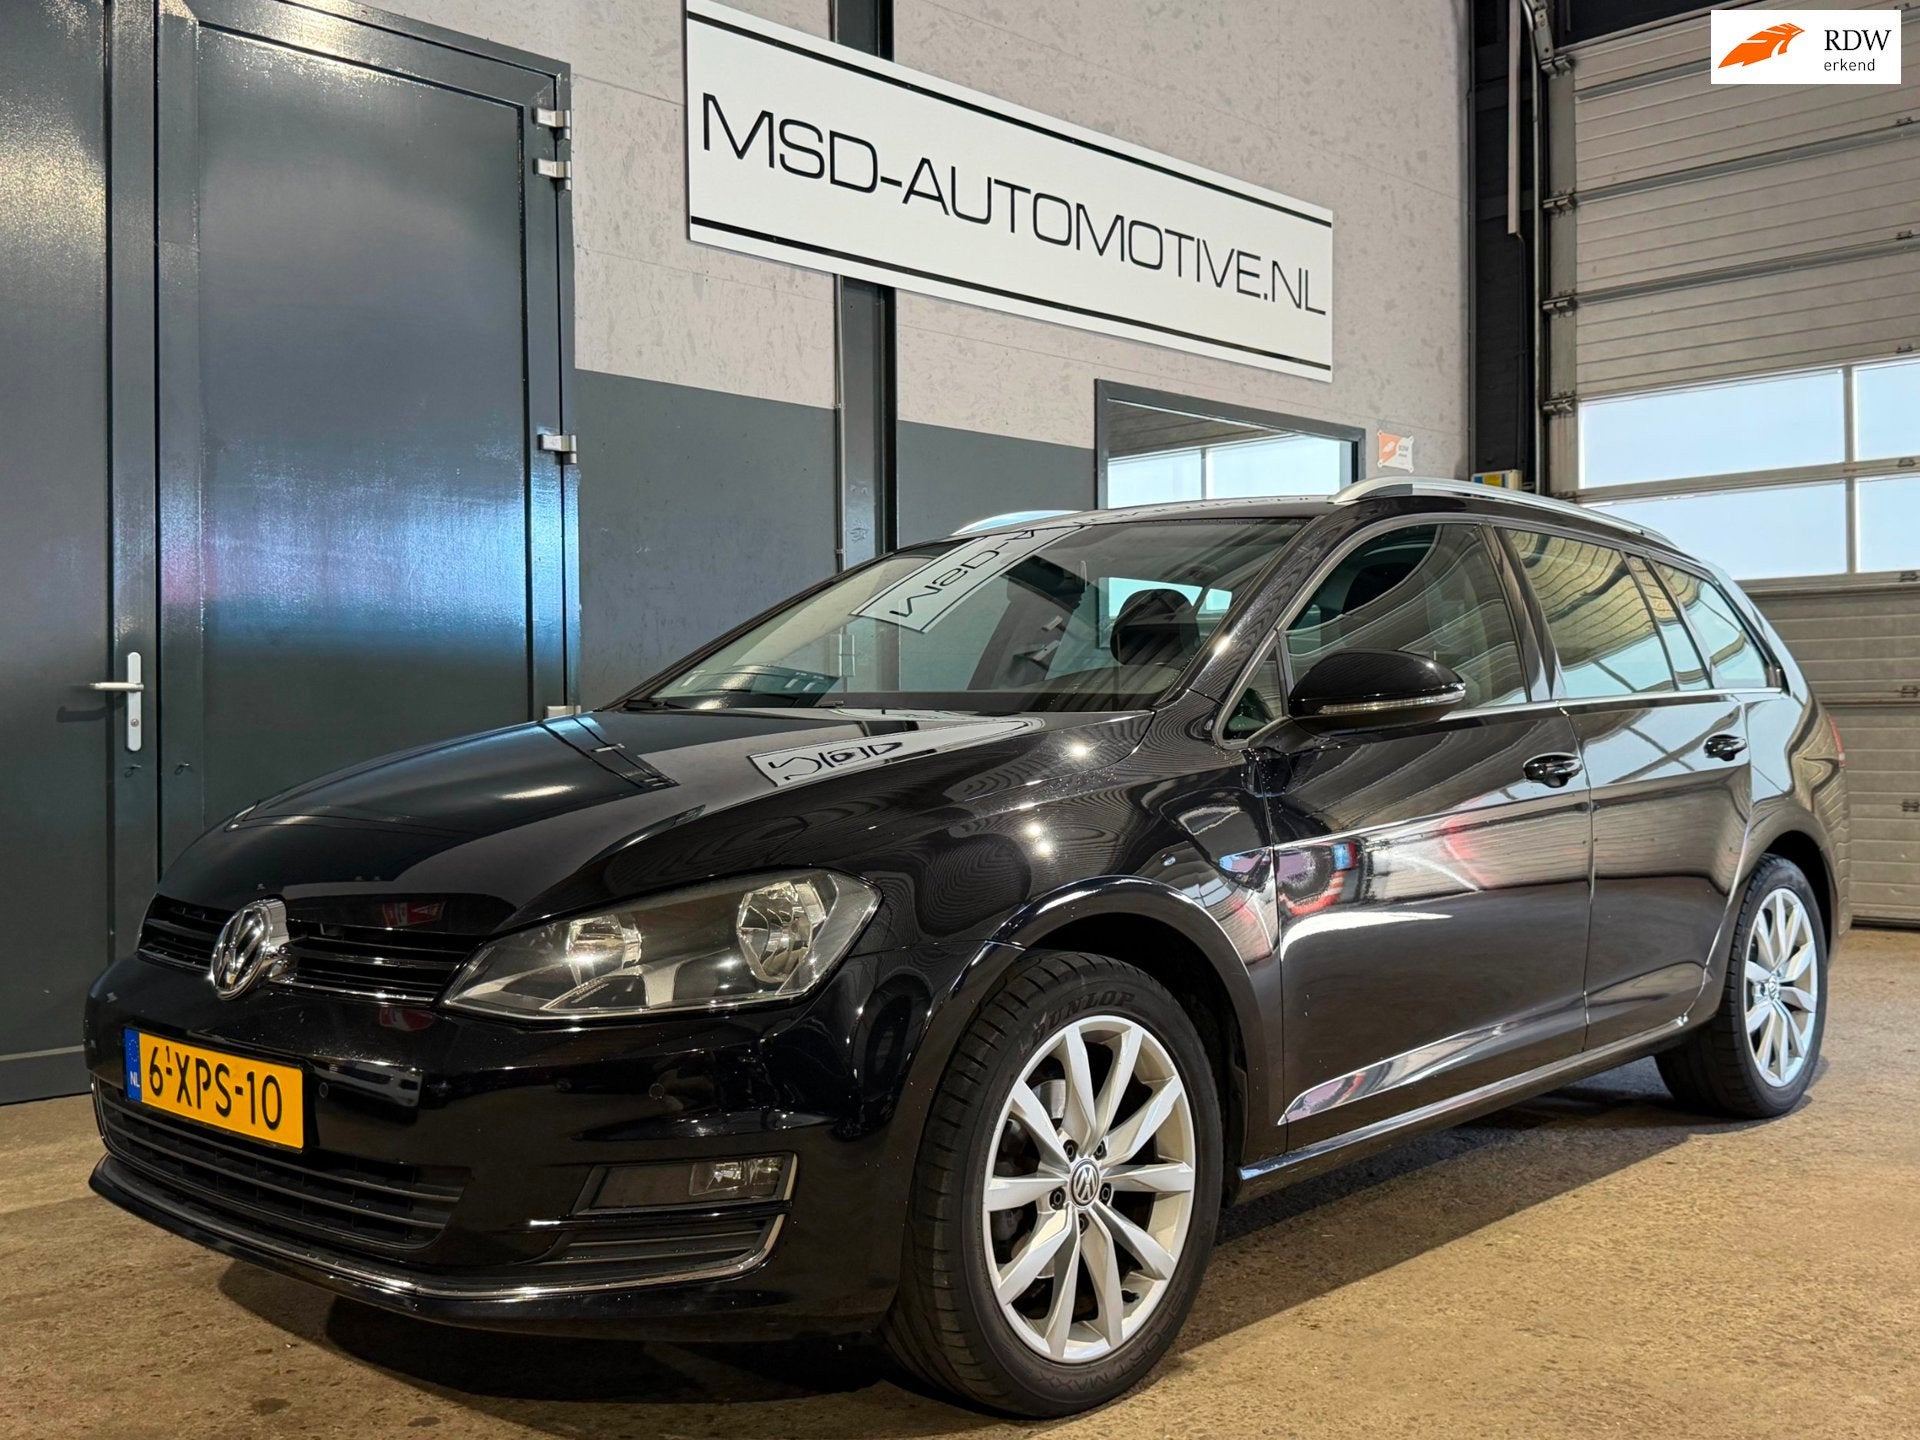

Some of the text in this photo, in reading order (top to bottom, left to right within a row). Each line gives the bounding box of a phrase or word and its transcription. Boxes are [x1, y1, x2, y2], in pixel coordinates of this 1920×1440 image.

[703, 92, 1326, 316] MSD-AUTOMOTIVE.NL
[129, 1046, 282, 1130] NL 6-XPS-10
